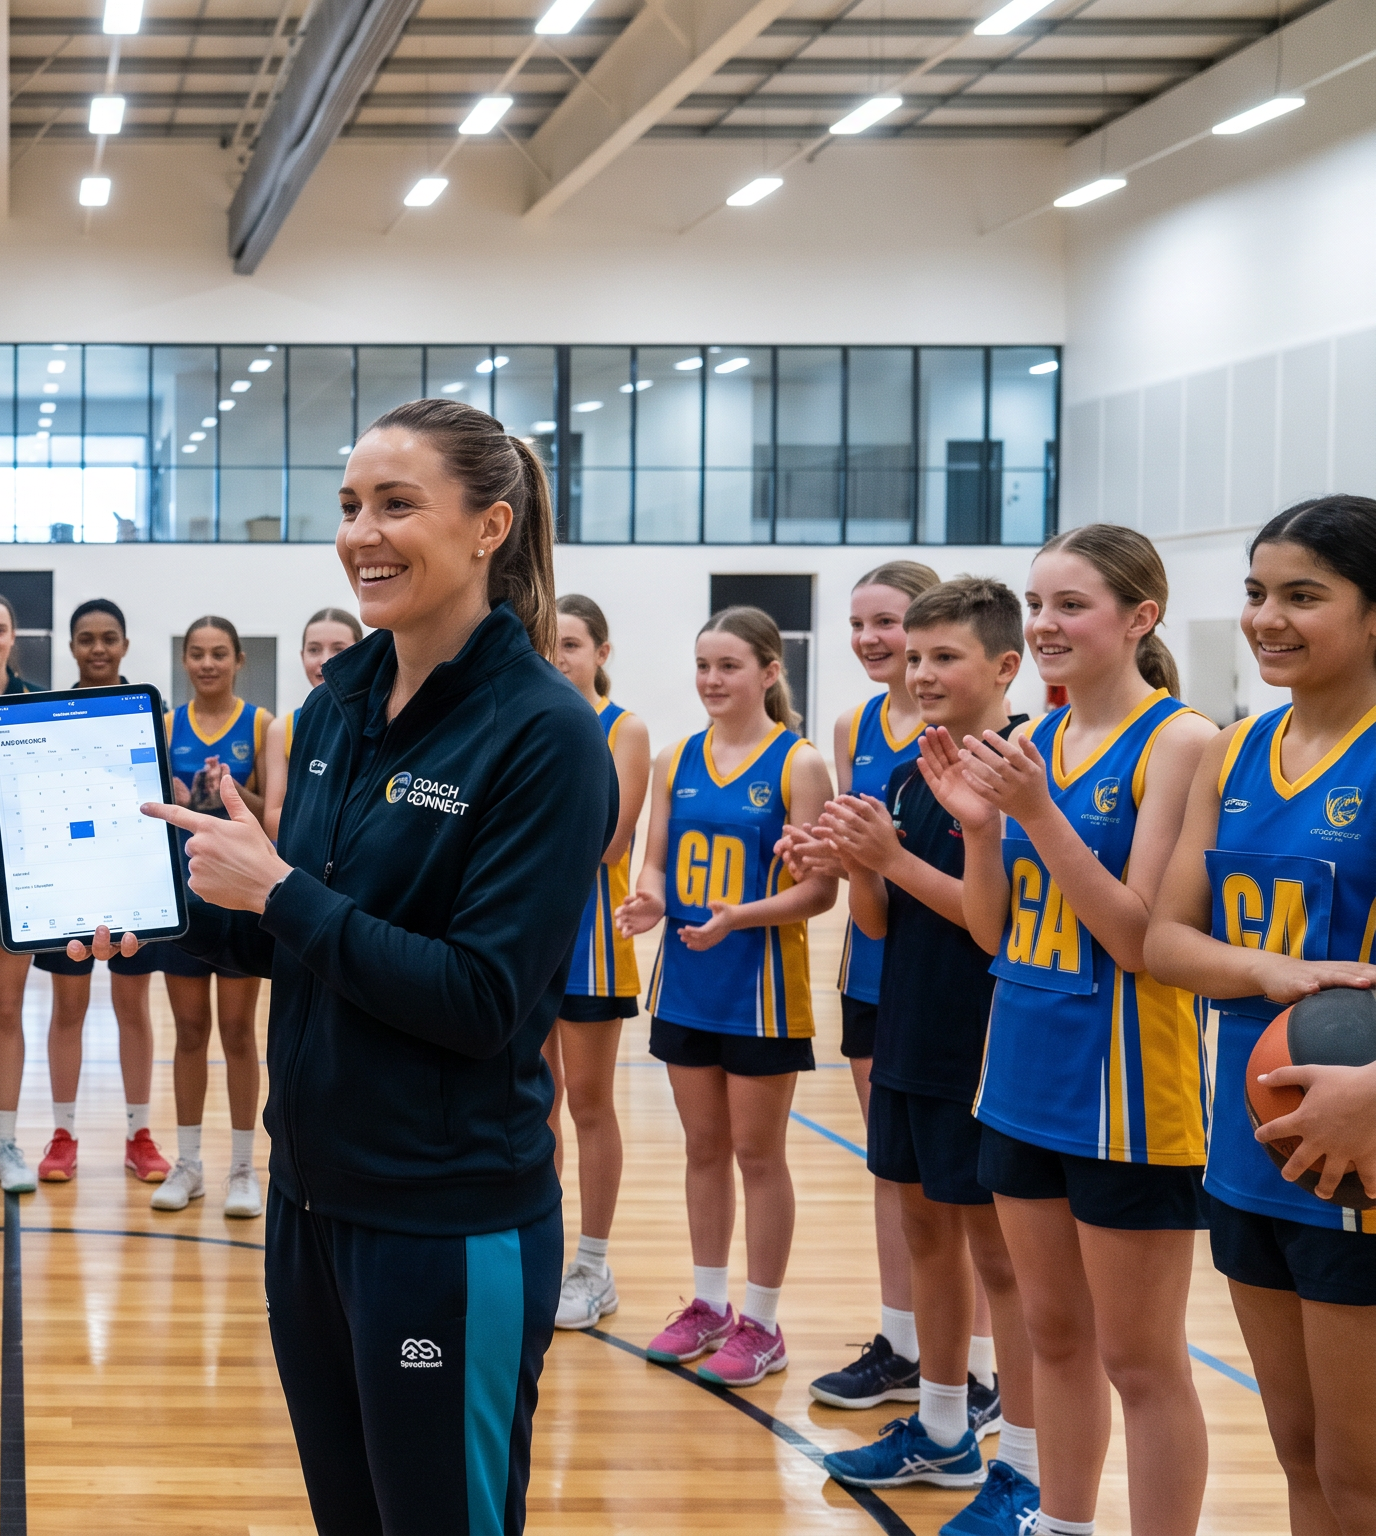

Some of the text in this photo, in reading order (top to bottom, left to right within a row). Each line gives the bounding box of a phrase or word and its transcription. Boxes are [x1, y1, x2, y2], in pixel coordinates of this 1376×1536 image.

[407, 790, 470, 816] CONNECT
[413, 777, 460, 800] COACH
[676, 829, 746, 908] GD
[1006, 856, 1081, 974] GA
